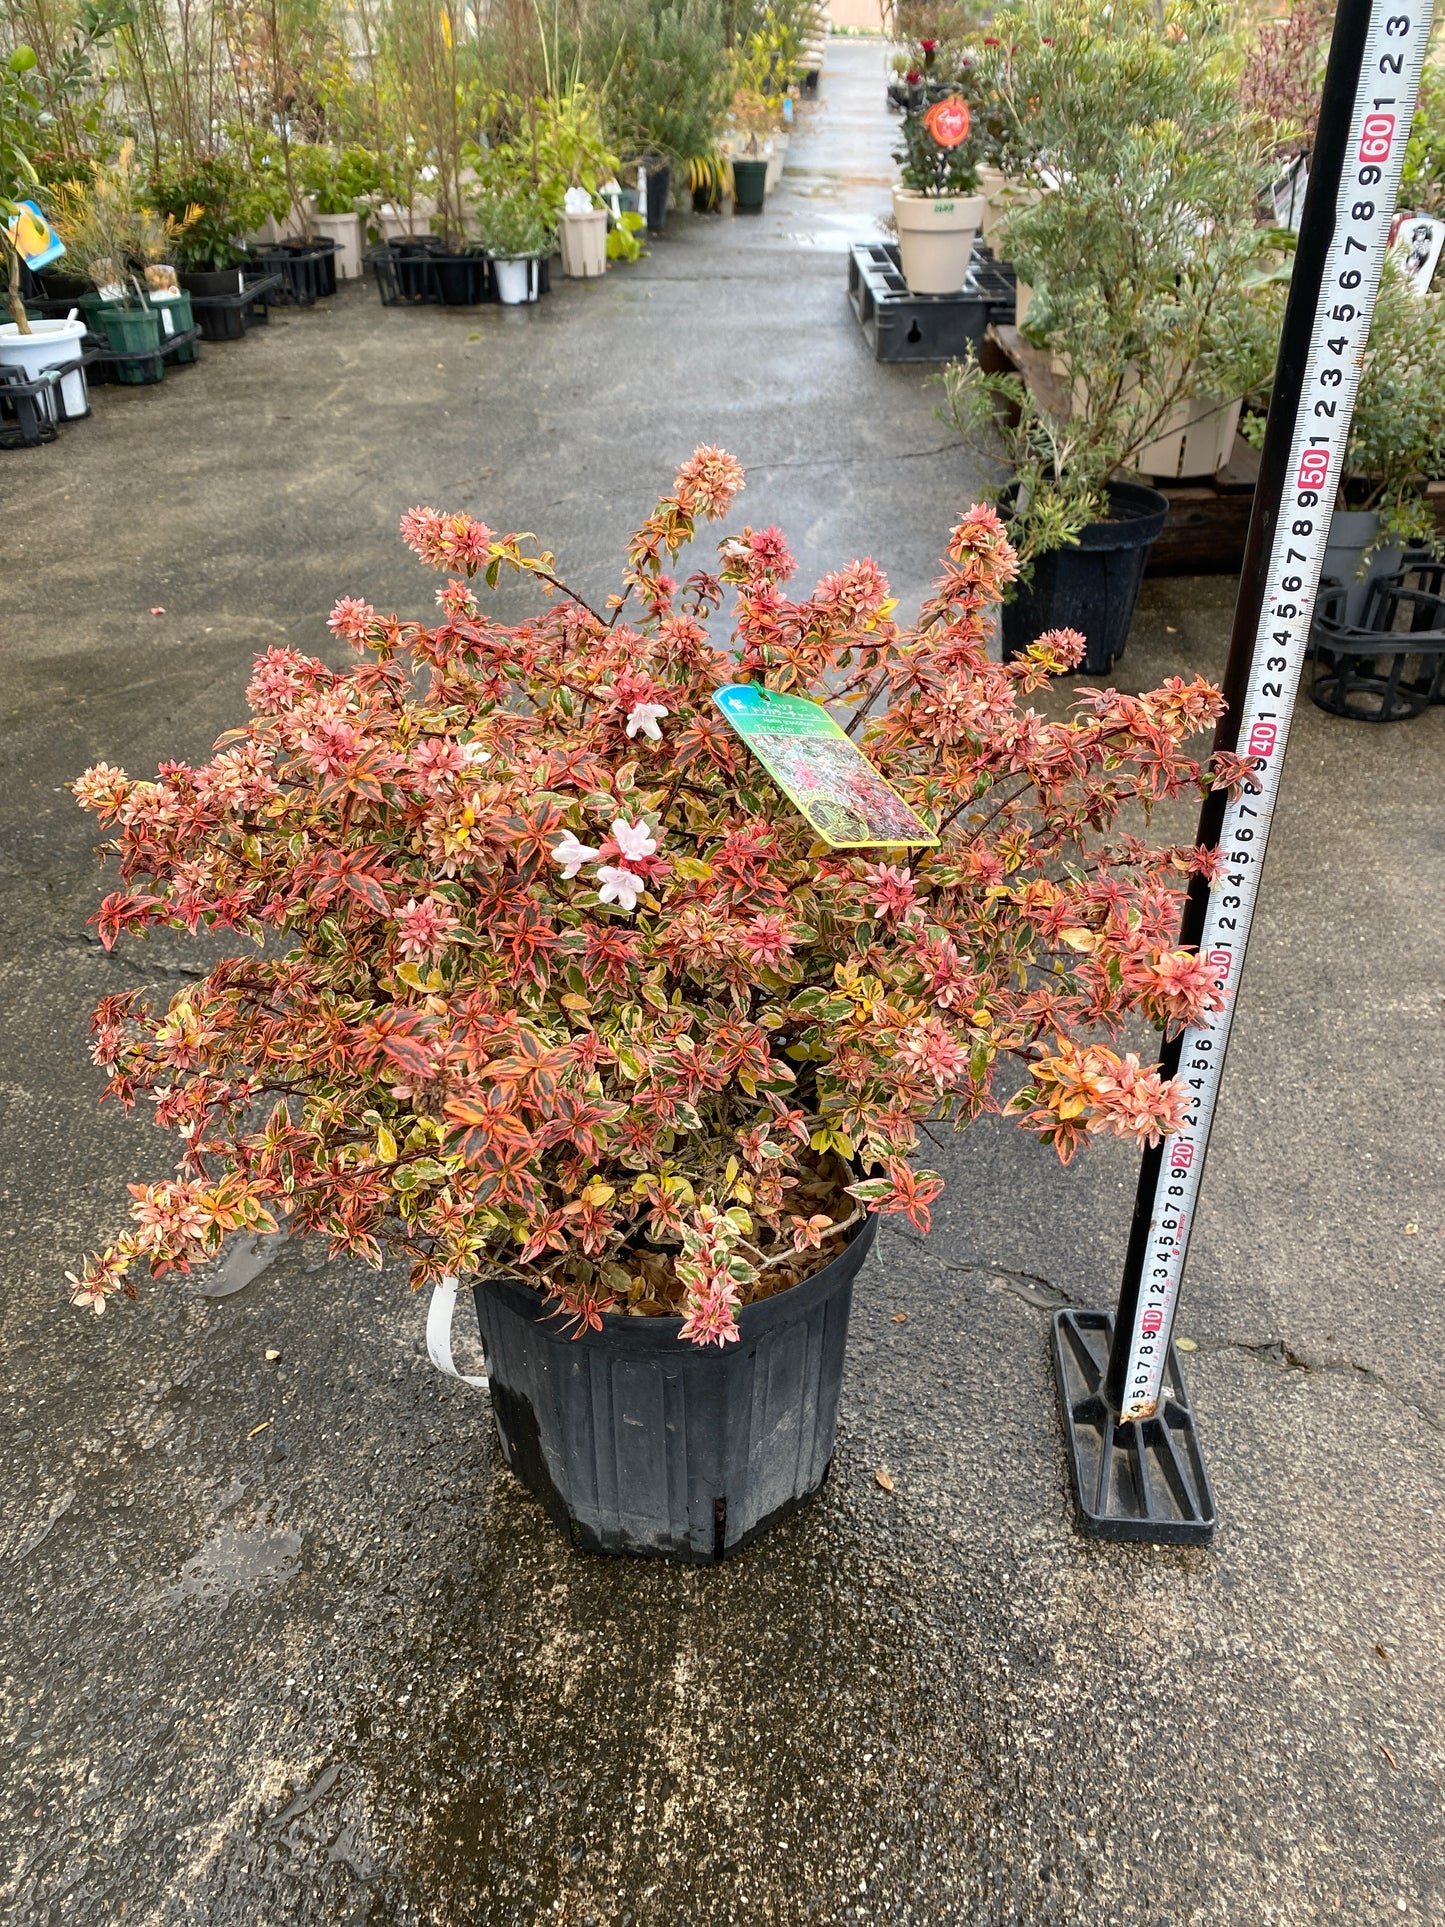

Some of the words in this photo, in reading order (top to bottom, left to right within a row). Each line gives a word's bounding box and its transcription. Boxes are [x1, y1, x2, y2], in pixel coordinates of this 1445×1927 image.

[1386, 15, 1410, 37] 3
[1379, 53, 1404, 74] 2
[1374, 97, 1396, 110] 1
[1362, 119, 1393, 156] 60
[1358, 165, 1382, 186] 9
[1351, 201, 1375, 221] 8
[1345, 236, 1367, 255] 7
[1338, 270, 1362, 290] 6
[1332, 304, 1355, 322] 5
[1327, 336, 1349, 356] 4
[1320, 368, 1343, 387] 3
[1314, 400, 1337, 418] 2
[1309, 436, 1330, 447] 1
[1300, 453, 1327, 485] 50
[1297, 490, 1319, 508] 9
[1291, 519, 1313, 537] 8
[1286, 548, 1307, 564] 7
[1281, 576, 1303, 592] 6
[1276, 603, 1297, 619] 5
[1272, 630, 1292, 647] 4
[1266, 657, 1287, 672] 3
[1262, 682, 1283, 698] 2
[1257, 712, 1277, 721] 1
[754, 723, 795, 733] Tricolor
[800, 728, 834, 737] Charm
[1251, 727, 1275, 753] 40
[1243, 781, 1263, 796] 8
[1238, 804, 1258, 818] 7
[1235, 828, 1254, 842] 6
[1230, 851, 1250, 865] 5
[1227, 873, 1245, 887] 4
[1222, 895, 1241, 909] 3
[1218, 917, 1237, 931] 2
[1214, 942, 1232, 950] 1
[1195, 1039, 1213, 1051] 6
[1191, 1059, 1209, 1071] 5
[1188, 1077, 1205, 1090] 4
[1181, 1114, 1198, 1127] 2
[1173, 1145, 1193, 1166] 20
[1171, 1168, 1188, 1179] 9
[1167, 1185, 1184, 1197] 8
[1164, 1202, 1180, 1212] 7
[1161, 1219, 1178, 1230] 6
[1158, 1236, 1175, 1246] 5
[1156, 1252, 1172, 1263] 4
[1152, 1268, 1168, 1278] 3
[1149, 1284, 1166, 1294] 2
[1144, 1312, 1162, 1328] 10
[1141, 1330, 1157, 1340] 9
[1139, 1345, 1154, 1355] 8
[1136, 1361, 1151, 1370] 7
[1134, 1375, 1148, 1384] 6
[1132, 1390, 1146, 1399] 5
[1130, 1404, 1143, 1413] 4
